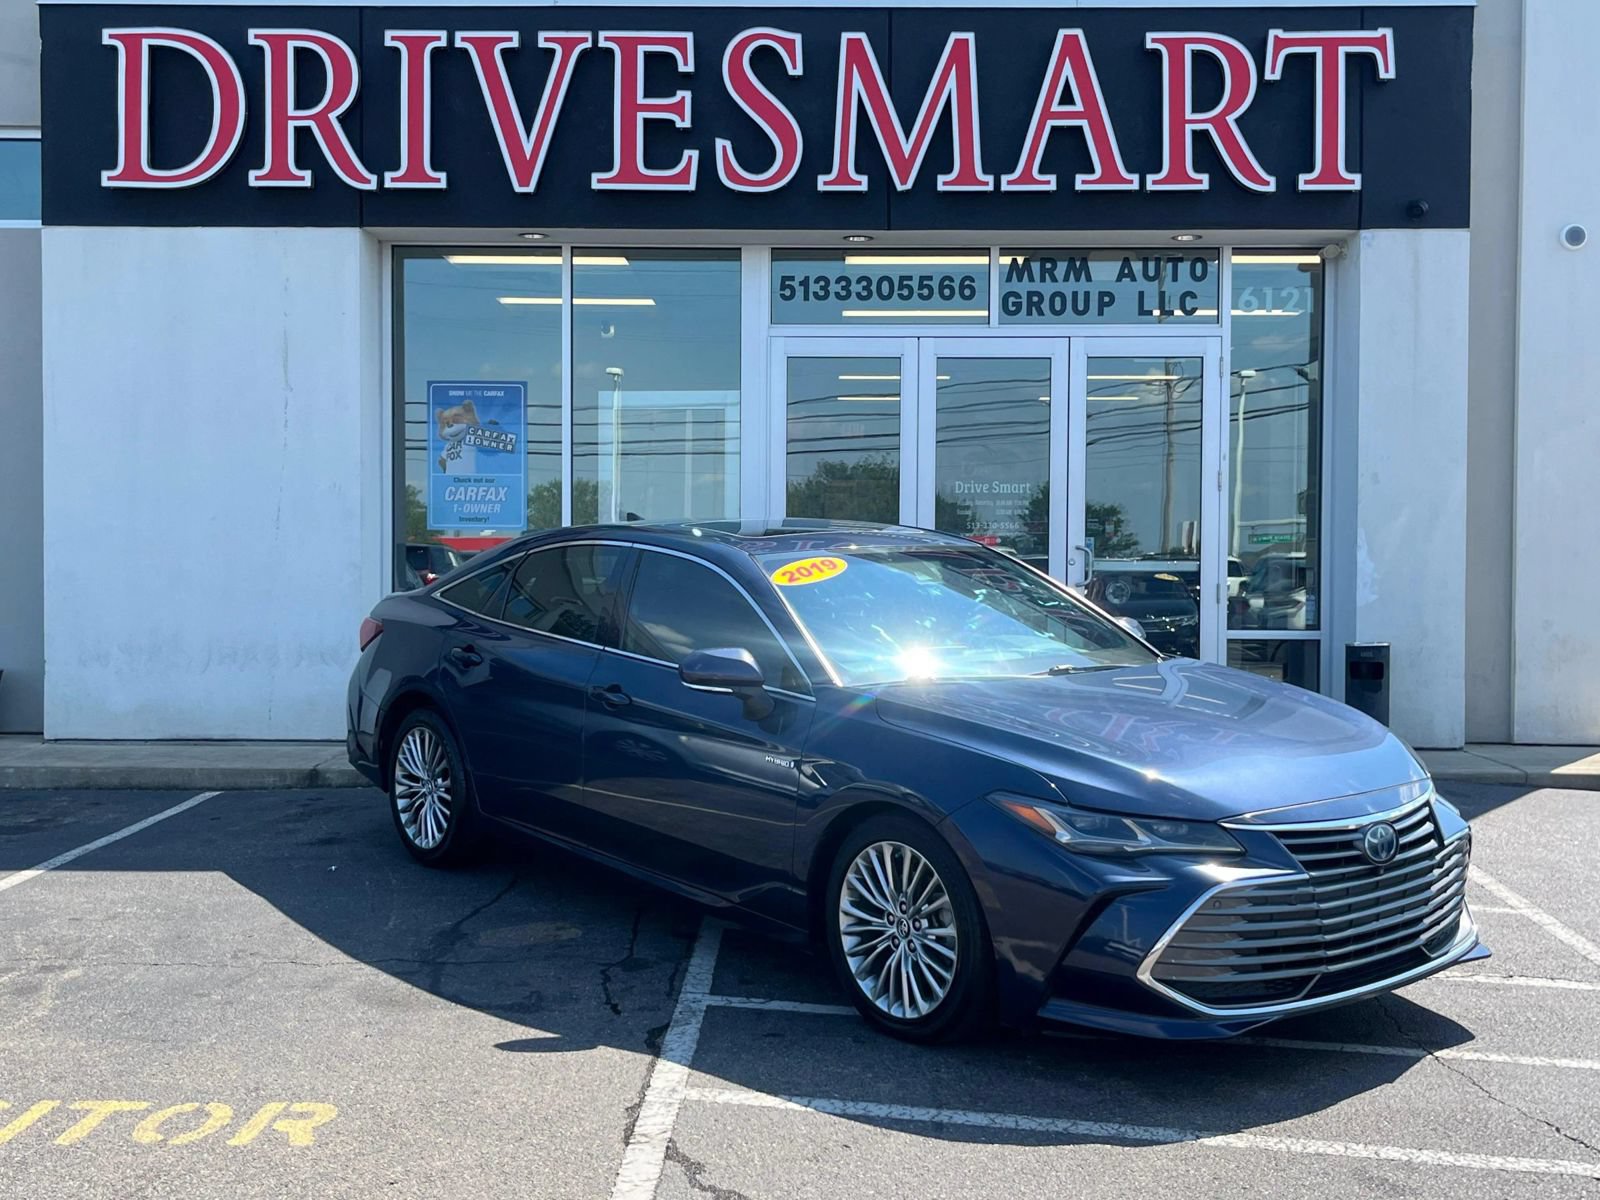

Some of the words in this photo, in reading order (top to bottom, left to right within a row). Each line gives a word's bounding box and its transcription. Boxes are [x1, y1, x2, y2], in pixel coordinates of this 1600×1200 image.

[101, 27, 1397, 194] DRIVESMART
[1005, 257, 1092, 283] MRM
[1116, 256, 1209, 283] AUTO
[779, 275, 977, 302] 5133305566
[1238, 286, 1314, 313] 6121
[1002, 290, 1115, 317] GROUP
[1138, 290, 1198, 317] LLC
[468, 427, 515, 443] CARFAX
[445, 486, 508, 502] CARFAX
[955, 480, 989, 494] Drive
[992, 480, 1031, 494] Smart
[781, 559, 837, 583] 2019
[765, 755, 790, 767] HYBRID
[0, 1099, 338, 1147] ITOR
